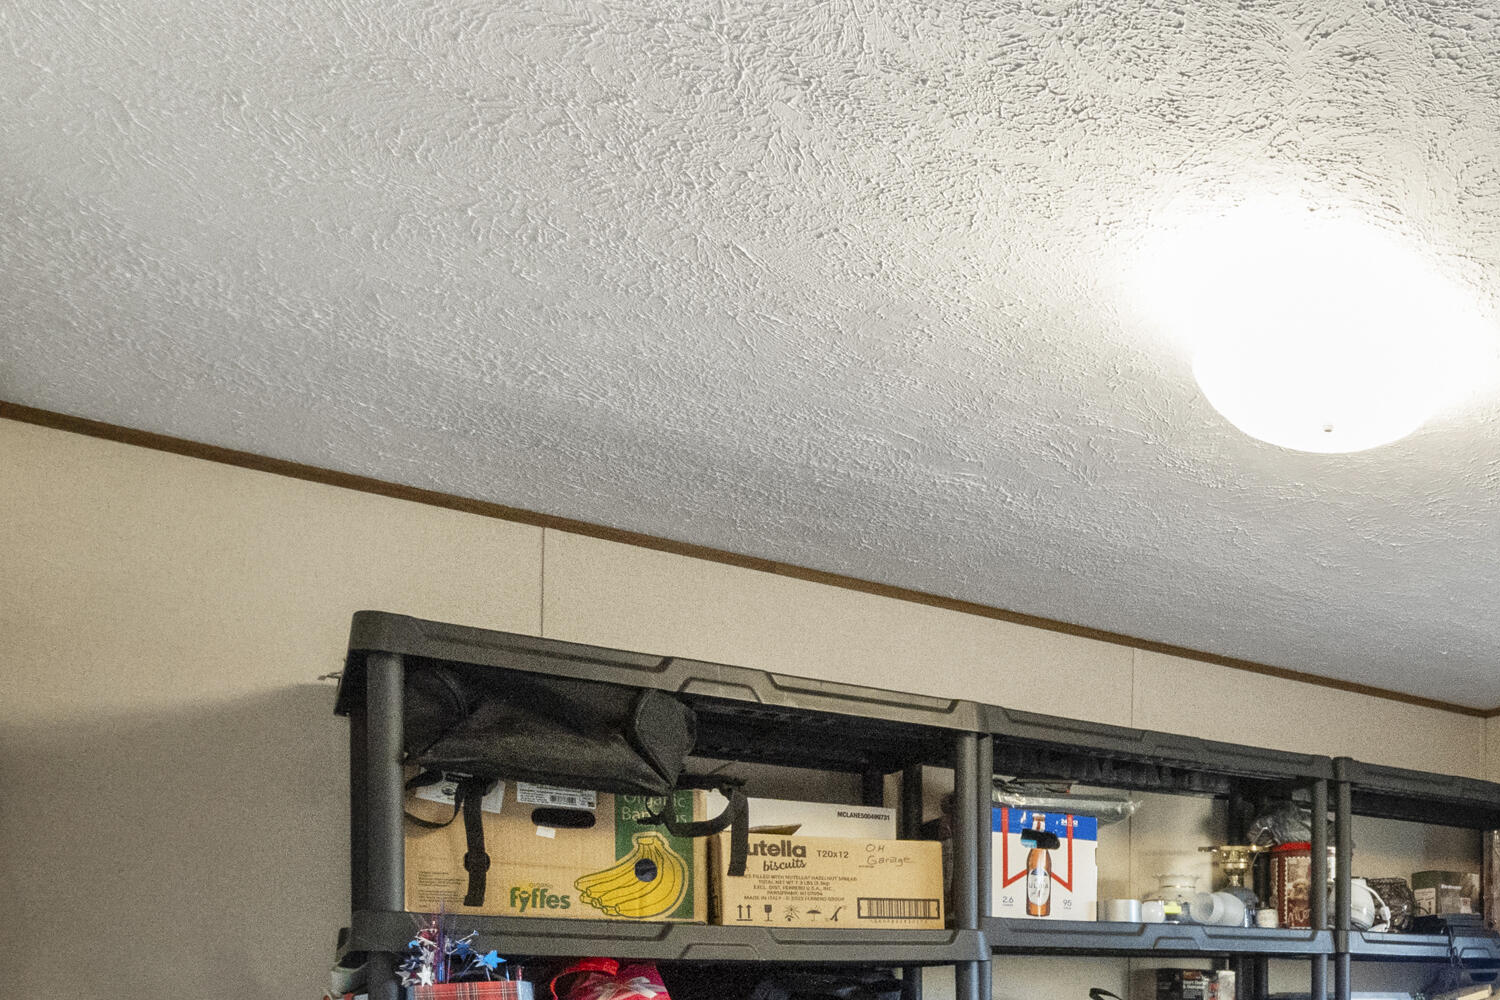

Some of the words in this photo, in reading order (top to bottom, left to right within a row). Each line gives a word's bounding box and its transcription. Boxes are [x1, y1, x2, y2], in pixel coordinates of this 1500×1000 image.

[746, 840, 807, 858] utella
[817, 850, 849, 859] T20x12
[763, 859, 807, 872] biscuits
[867, 855, 913, 866] Garage
[509, 886, 571, 912] fyffes
[1063, 899, 1072, 907] 95
